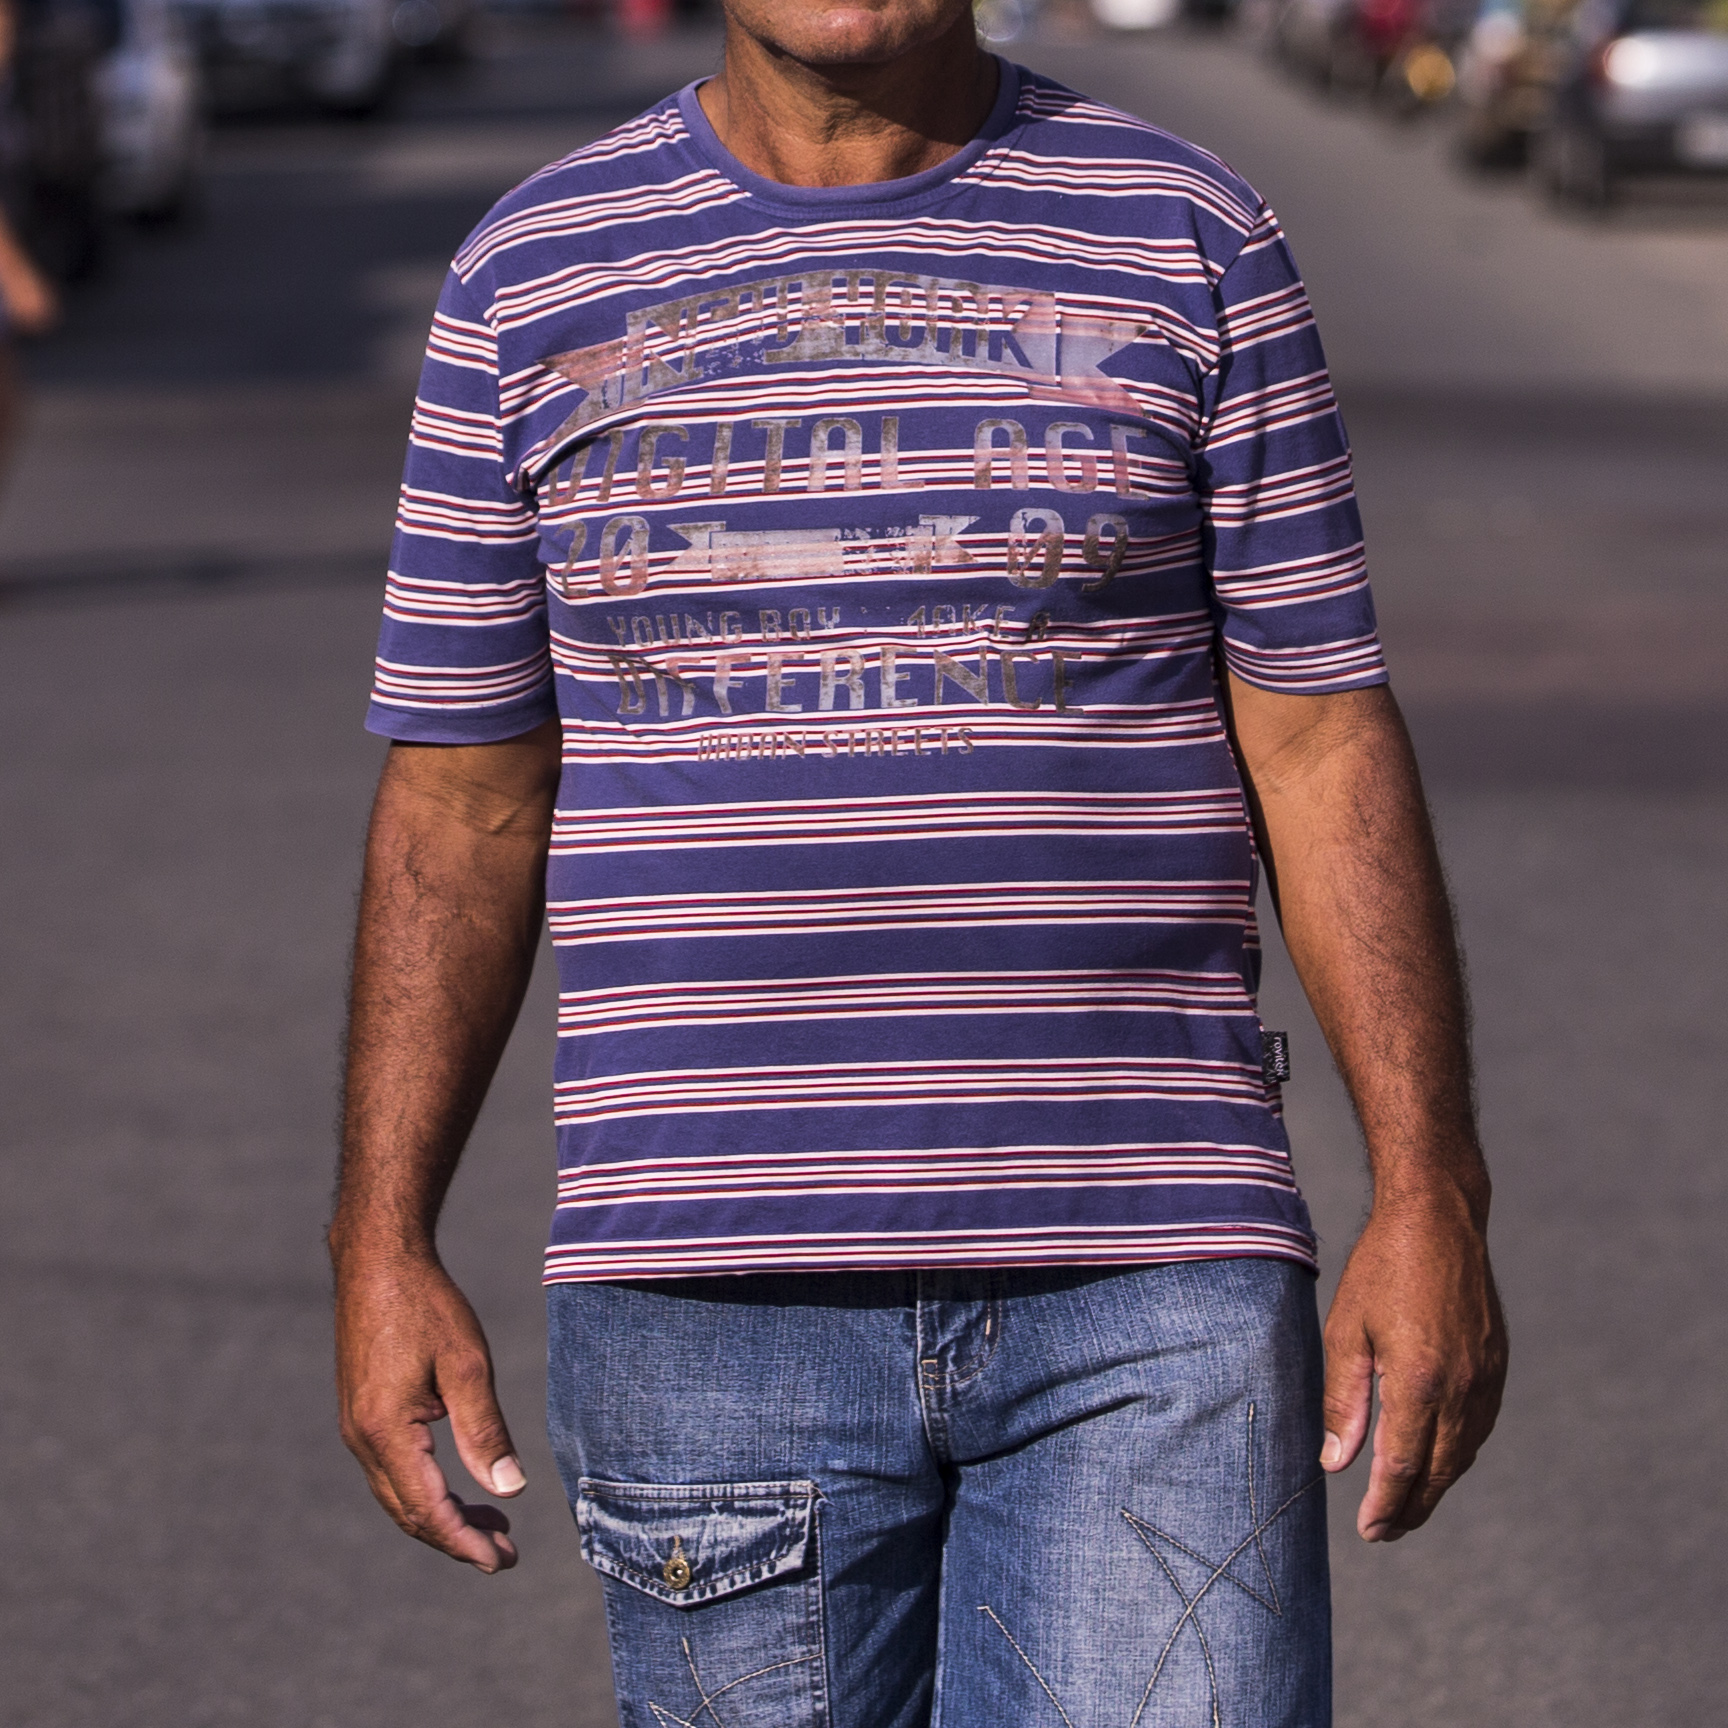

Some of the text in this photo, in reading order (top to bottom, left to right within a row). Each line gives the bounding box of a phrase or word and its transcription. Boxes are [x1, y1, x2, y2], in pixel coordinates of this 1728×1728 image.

[830, 277, 1034, 369] YORK
[548, 416, 1149, 506] DIGITAL AGE
[554, 508, 1129, 597] 20 09
[607, 610, 744, 648] YOUNG
[759, 607, 840, 642] BOY
[607, 645, 1084, 717] DIFFERENCE
[698, 727, 974, 762] URBAN STREETS
